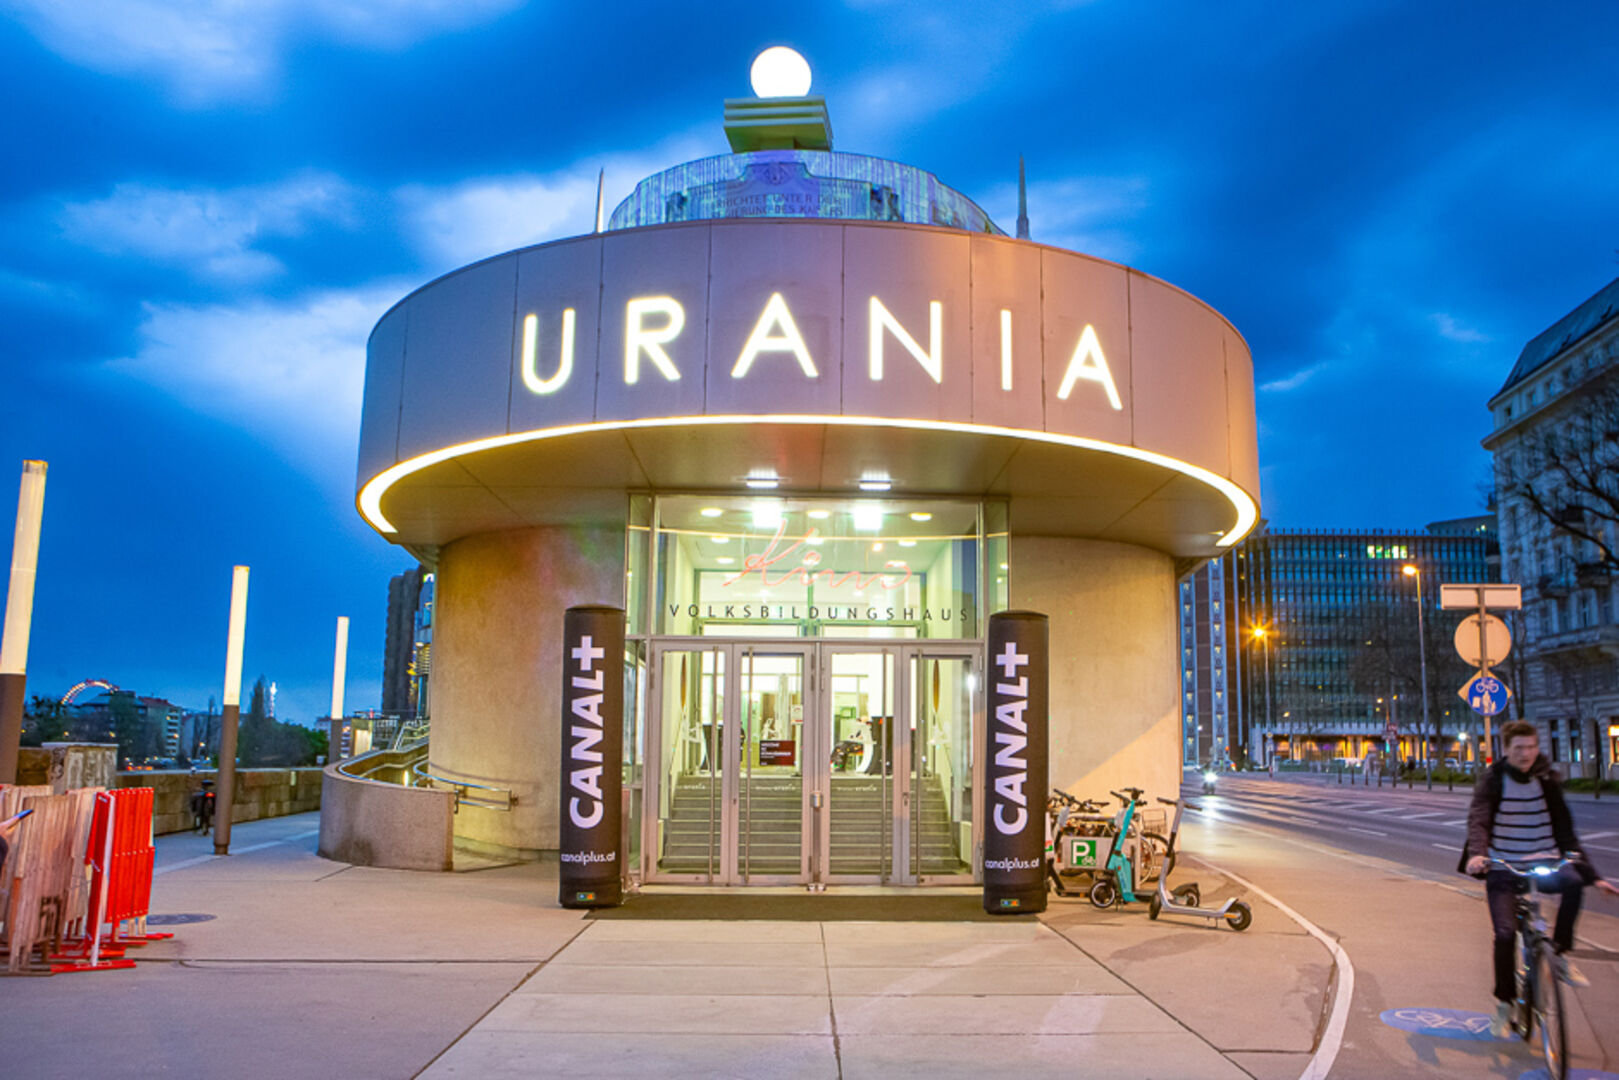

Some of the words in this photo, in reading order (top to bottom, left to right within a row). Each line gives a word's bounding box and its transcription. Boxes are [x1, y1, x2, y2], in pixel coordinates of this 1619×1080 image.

[520, 291, 1123, 411] URANIA
[723, 517, 912, 590] Kino
[669, 603, 968, 621] VOLKSBILDUNGSHAUS
[569, 635, 605, 829] CANAL+
[993, 642, 1029, 836] CANAL+
[1072, 842, 1091, 865] P
